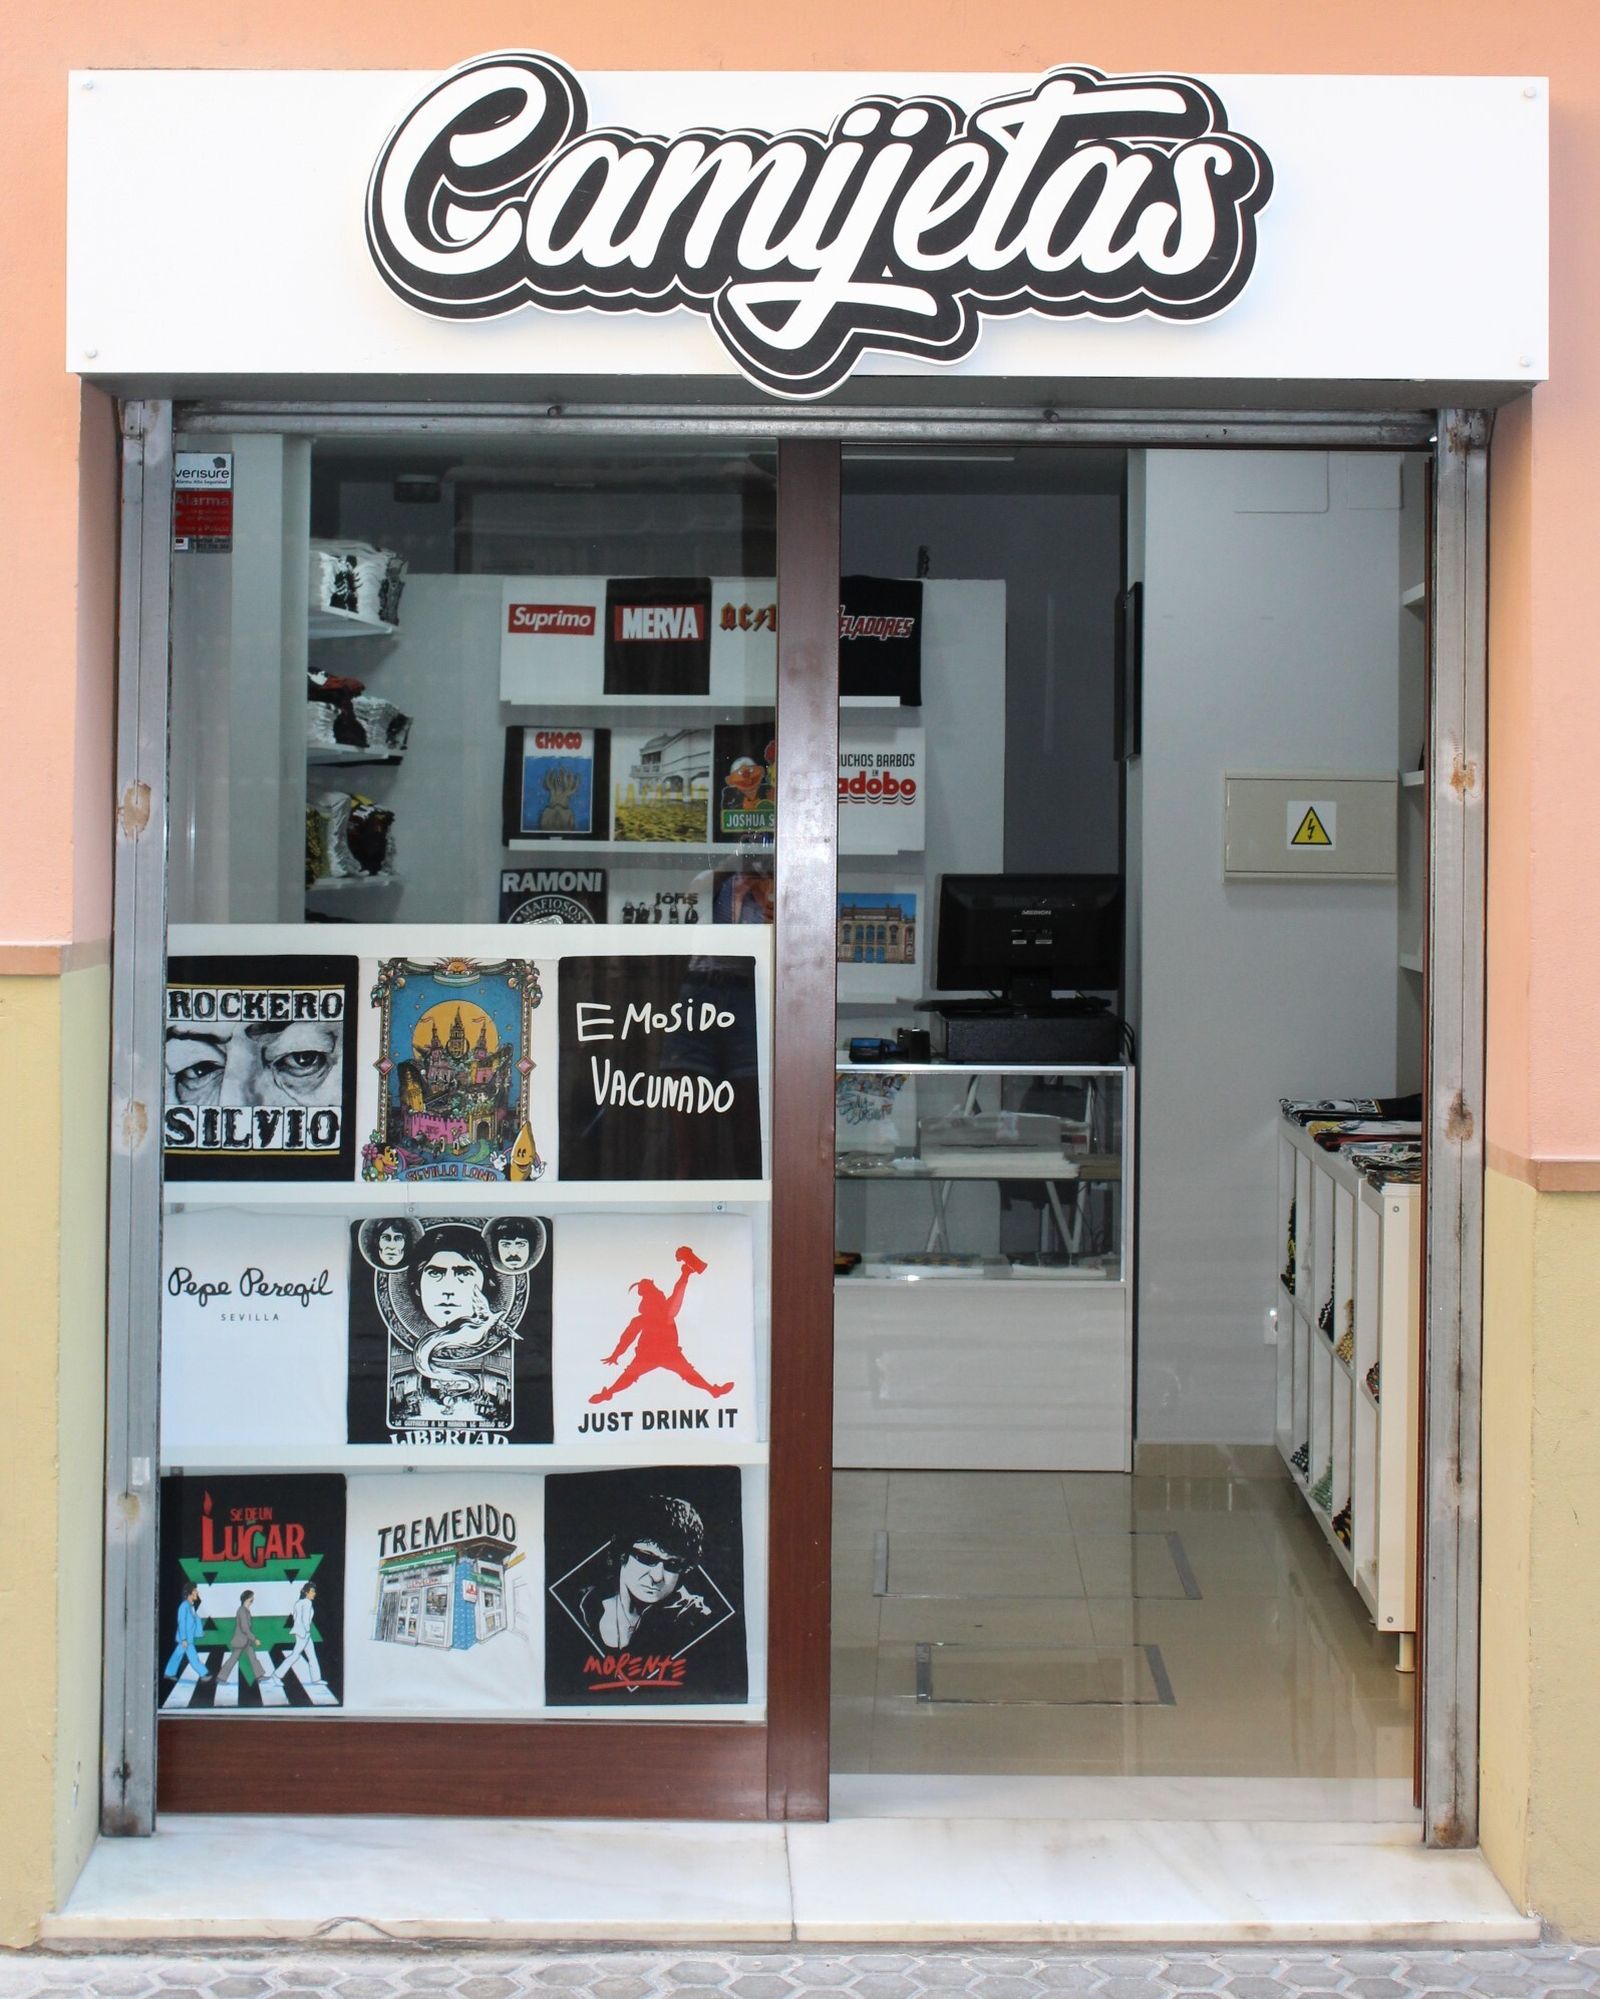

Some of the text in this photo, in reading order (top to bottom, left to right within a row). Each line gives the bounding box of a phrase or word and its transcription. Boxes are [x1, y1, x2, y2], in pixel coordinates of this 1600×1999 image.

[376, 62, 1236, 352] Camijetas
[513, 606, 591, 631] Suprimo
[622, 607, 699, 639] MERVA
[535, 731, 583, 750] CHOCO
[839, 753, 916, 768] UCHOS BARBOS
[726, 813, 766, 828] JOSHUA
[502, 872, 602, 893] RAMONI
[519, 898, 585, 921] MAFIOSOS
[168, 989, 344, 1021] ROCKERO
[591, 1055, 735, 1114] VACUNADO
[164, 1105, 340, 1149] SILVIO
[168, 1266, 233, 1307] Pepe
[220, 1313, 280, 1322] SEVILLA
[578, 1408, 738, 1433] JUST DRINK IT
[389, 1429, 510, 1445] LIBERTAD
[201, 1515, 306, 1568] LUGAR
[377, 1503, 516, 1557] TREMENDO
[583, 1653, 687, 1683] MORENTE
